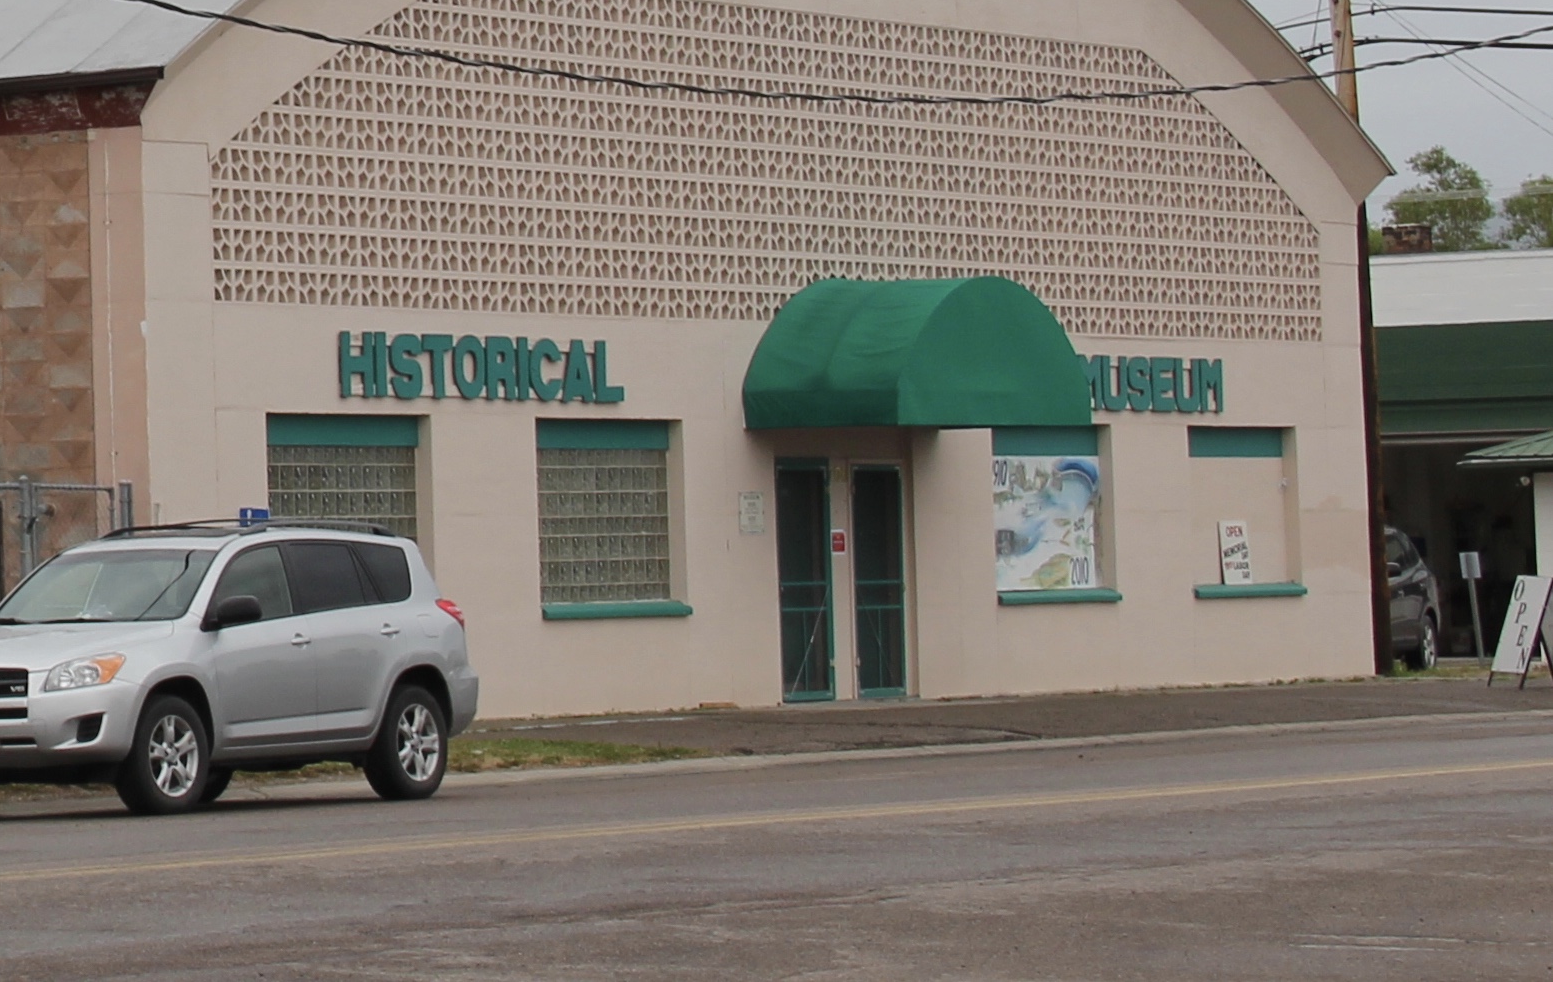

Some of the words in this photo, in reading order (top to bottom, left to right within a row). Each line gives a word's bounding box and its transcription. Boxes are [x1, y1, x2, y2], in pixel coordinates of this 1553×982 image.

[338, 330, 625, 404] HISTORICAL
[1075, 354, 1224, 414] MUSEUM
[1225, 525, 1243, 538] OPEN
[1069, 556, 1090, 585] 2010
[1513, 579, 1530, 670] OPEN
